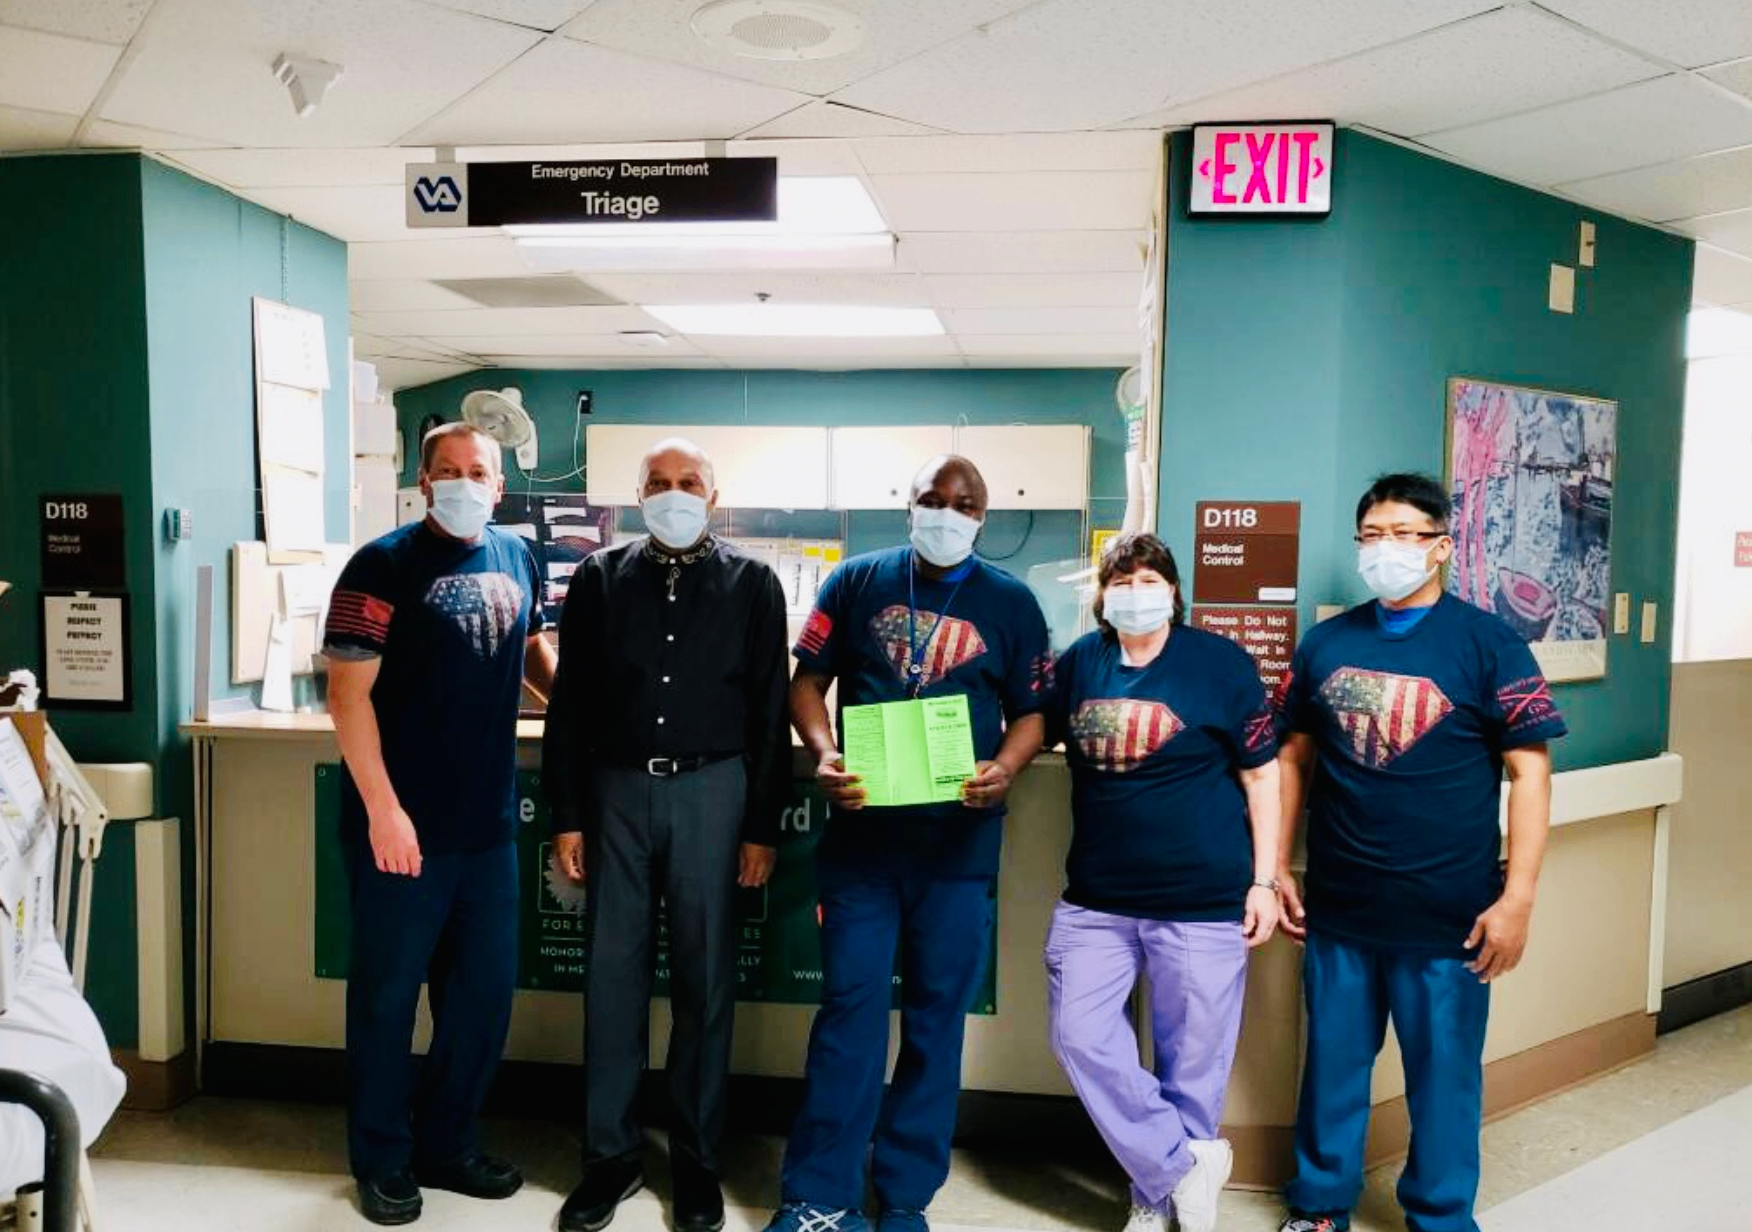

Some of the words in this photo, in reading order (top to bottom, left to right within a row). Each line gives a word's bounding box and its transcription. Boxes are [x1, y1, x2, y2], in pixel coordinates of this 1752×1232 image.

[531, 163, 614, 181] Emergency
[620, 162, 709, 179] Department
[1212, 133, 1319, 204] EXIT
[580, 190, 660, 219] Triage
[45, 501, 89, 520] D118
[1203, 508, 1258, 528] D118
[1202, 543, 1244, 554] Medical
[1202, 554, 1244, 566] Control
[1202, 614, 1239, 626] Please
[1244, 615, 1262, 625] Do
[1266, 615, 1288, 627] Not
[1244, 630, 1291, 643] Hallway.
[1244, 645, 1269, 656] Wait
[1275, 645, 1286, 655] In
[542, 919, 571, 931] FOR
